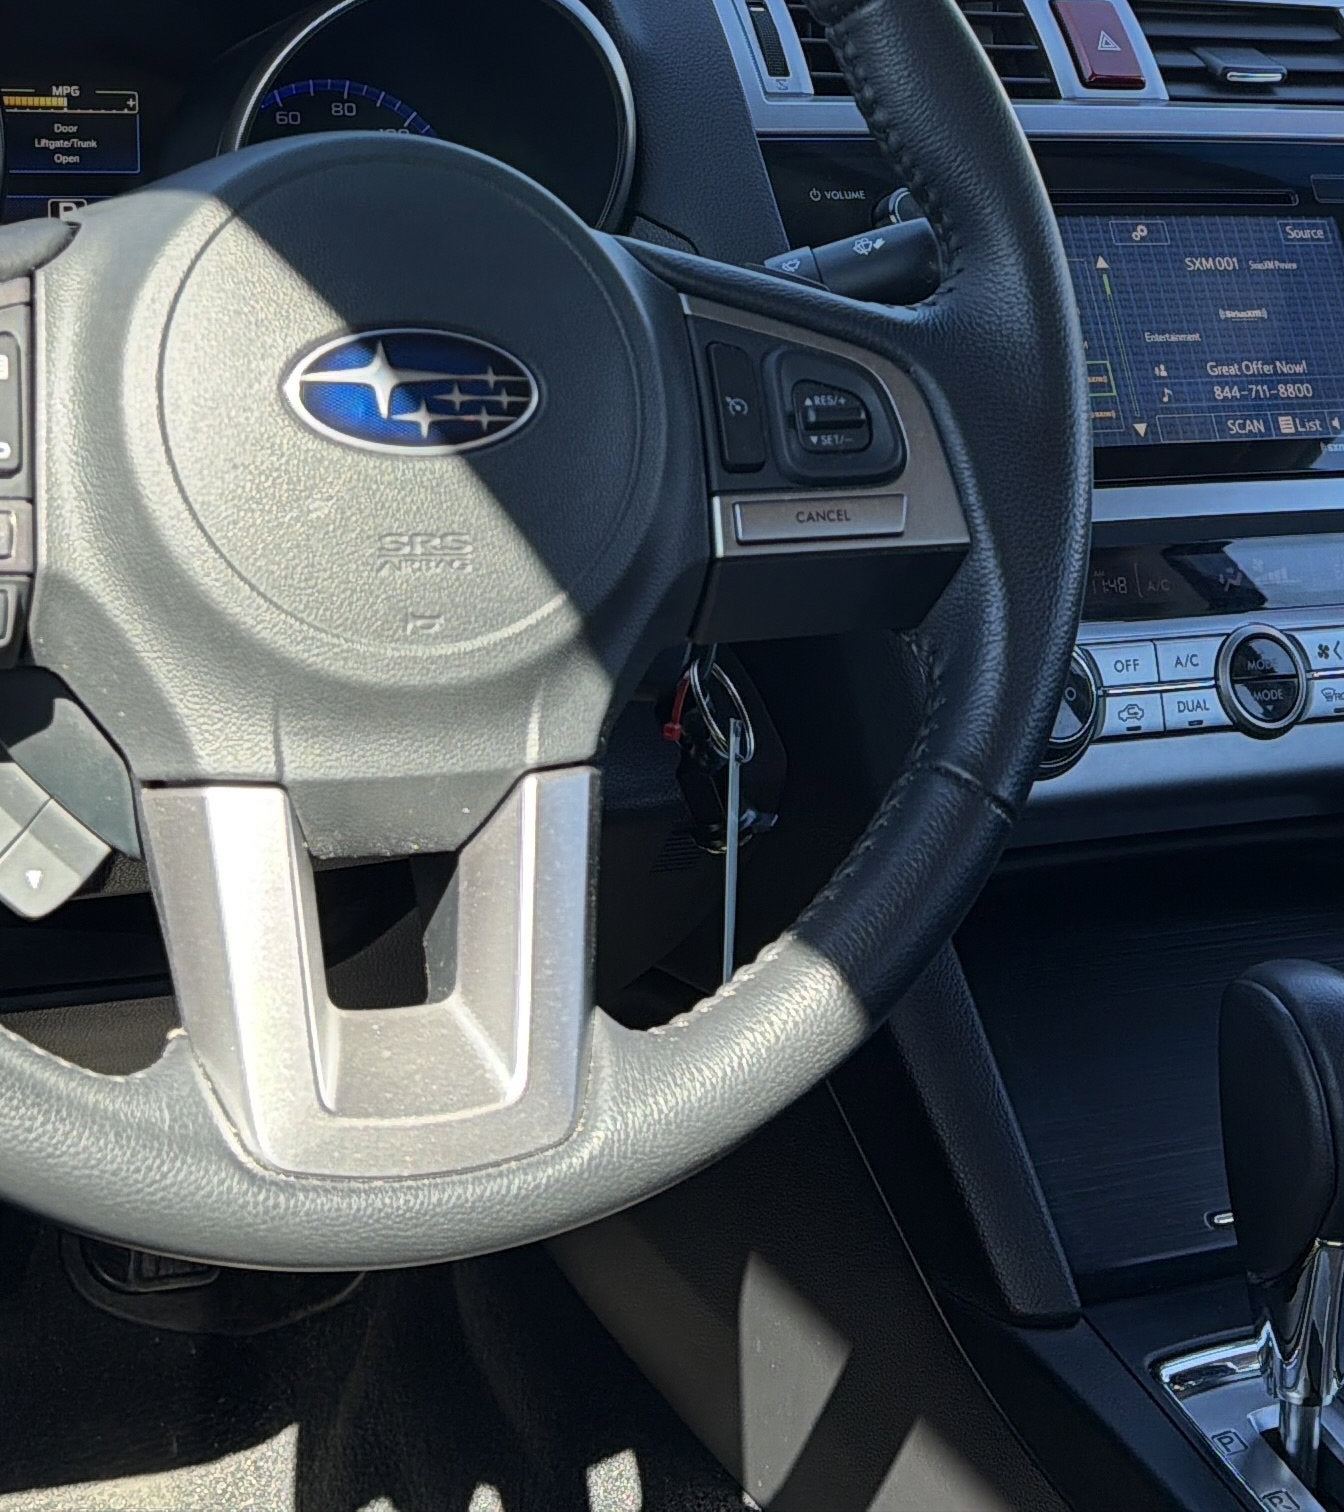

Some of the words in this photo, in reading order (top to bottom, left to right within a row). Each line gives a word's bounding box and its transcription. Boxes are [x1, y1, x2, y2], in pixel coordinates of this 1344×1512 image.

[52, 85, 80, 97] MPG
[331, 102, 356, 117] 80
[275, 111, 301, 125] 60
[54, 123, 79, 133] Door
[34, 138, 98, 149] Liftgate/Trunk
[53, 154, 80, 165] Open
[824, 190, 866, 200] VOLUME
[1285, 225, 1324, 239] Source
[1184, 256, 1214, 271] SXM
[1215, 256, 1239, 271] 001
[1144, 331, 1201, 343] Entertainment
[1207, 361, 1239, 376] Great
[1241, 360, 1274, 375] Offer
[1276, 359, 1307, 374] Now!
[1213, 383, 1313, 400] 844-711-8800
[1226, 419, 1265, 433] SCAN
[1296, 417, 1322, 432] List
[796, 509, 851, 523] CANCEL
[1113, 658, 1141, 674] OFF
[1174, 653, 1200, 670] A/C
[1247, 658, 1279, 671] MODE
[1253, 689, 1284, 701] MODE
[1176, 698, 1210, 714] DUAL
